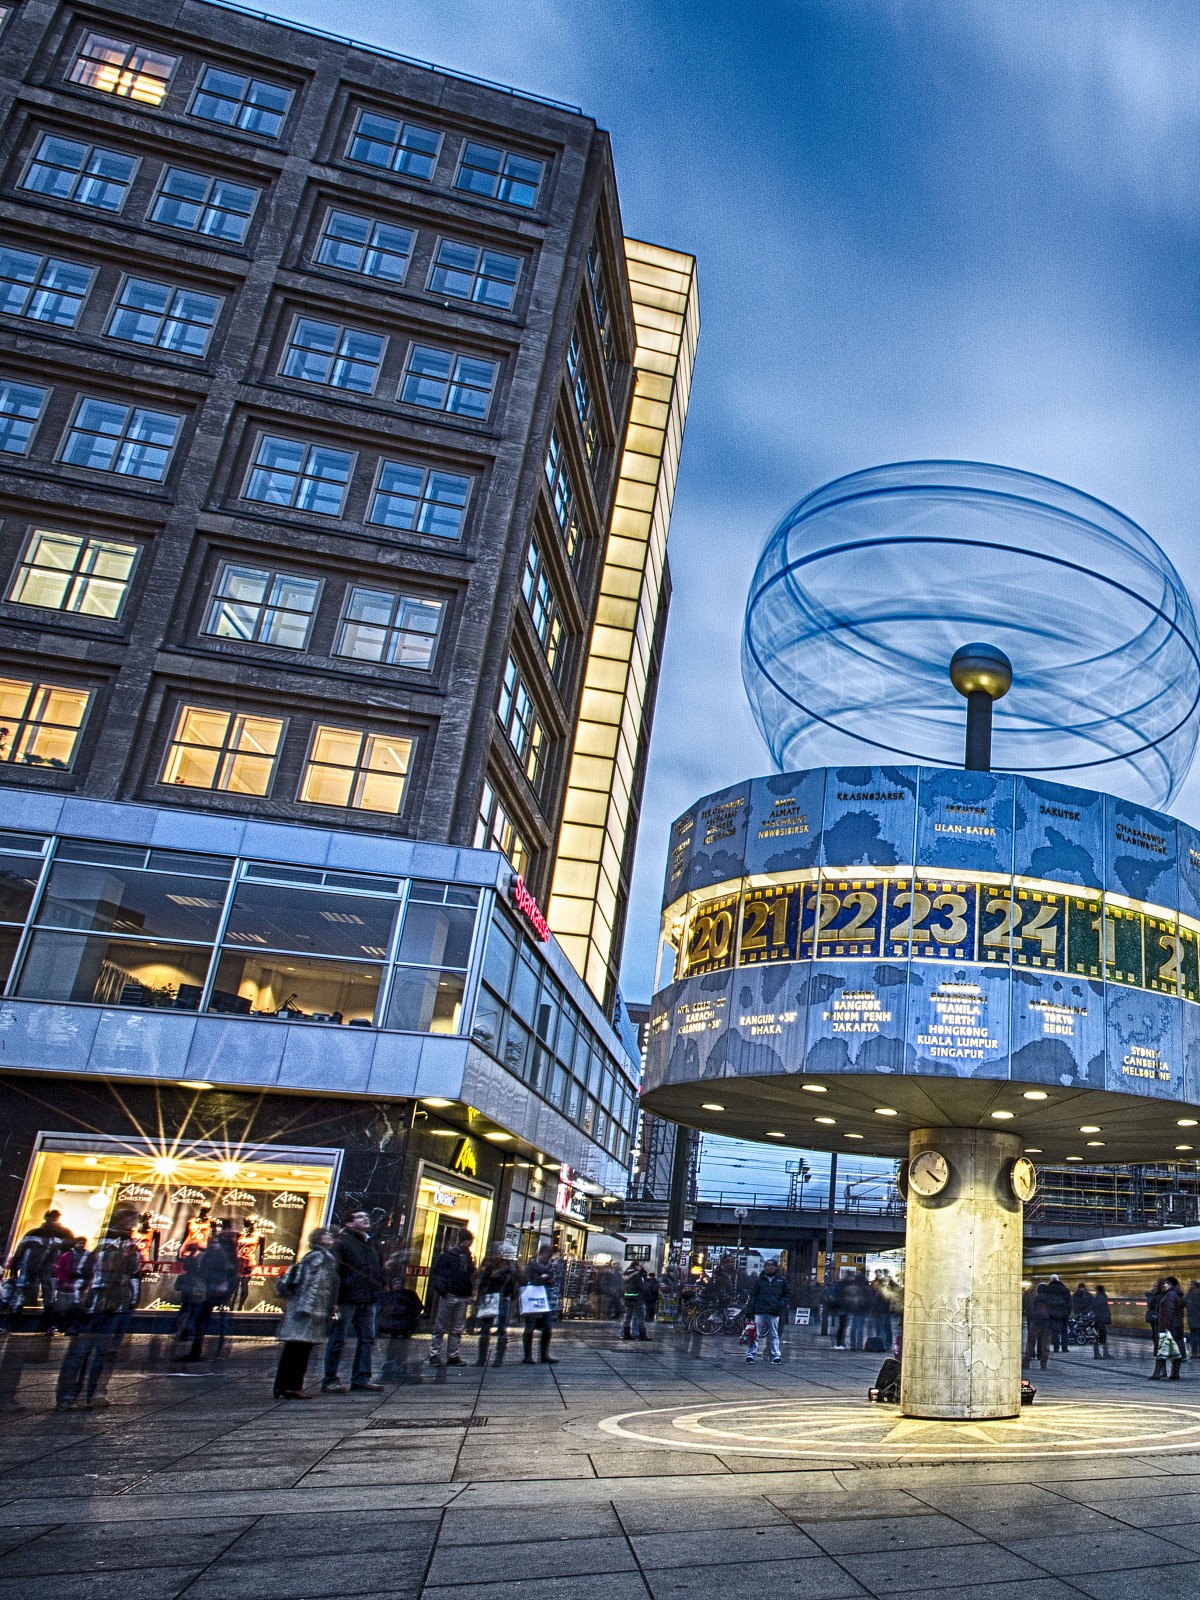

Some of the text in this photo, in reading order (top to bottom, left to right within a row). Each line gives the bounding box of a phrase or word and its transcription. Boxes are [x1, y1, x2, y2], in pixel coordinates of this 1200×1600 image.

[836, 792, 905, 801] KRASNOJARSK
[769, 806, 801, 818] ALMATY
[1039, 805, 1081, 821] JAKUTSK
[762, 815, 808, 828] TASCHKENT
[757, 824, 809, 839] NOWOSIBIRSK
[934, 823, 997, 836] ULAN-BATOR
[515, 874, 550, 943] Sparkasse
[687, 911, 733, 965] 20
[741, 897, 788, 950] 21
[802, 892, 877, 942] 22
[889, 892, 968, 944] 23
[983, 899, 1059, 954] 24
[1091, 915, 1116, 966] 1
[1158, 935, 1185, 986] 2
[833, 1000, 881, 1011] BANGKOK
[937, 1003, 981, 1015] MANILA
[685, 1010, 715, 1023] KARACHI
[739, 1014, 774, 1026] RANGUN
[823, 1011, 891, 1022] PHNOM PENH
[942, 1014, 975, 1026] PERTH
[1043, 1012, 1074, 1025] TOKYO
[751, 1025, 782, 1036] DHAKA
[832, 1022, 880, 1032] JAKARTA
[929, 1024, 988, 1036] HONGKONG
[1043, 1023, 1074, 1036] SEOUL
[917, 1034, 998, 1049] KUALA LUMPUR
[930, 1047, 984, 1059] SINGAPUR
[1131, 1046, 1161, 1058] SYDNEY
[1122, 1065, 1171, 1082] MELBOURNE
[272, 1201, 305, 1209] CHRISTINE
